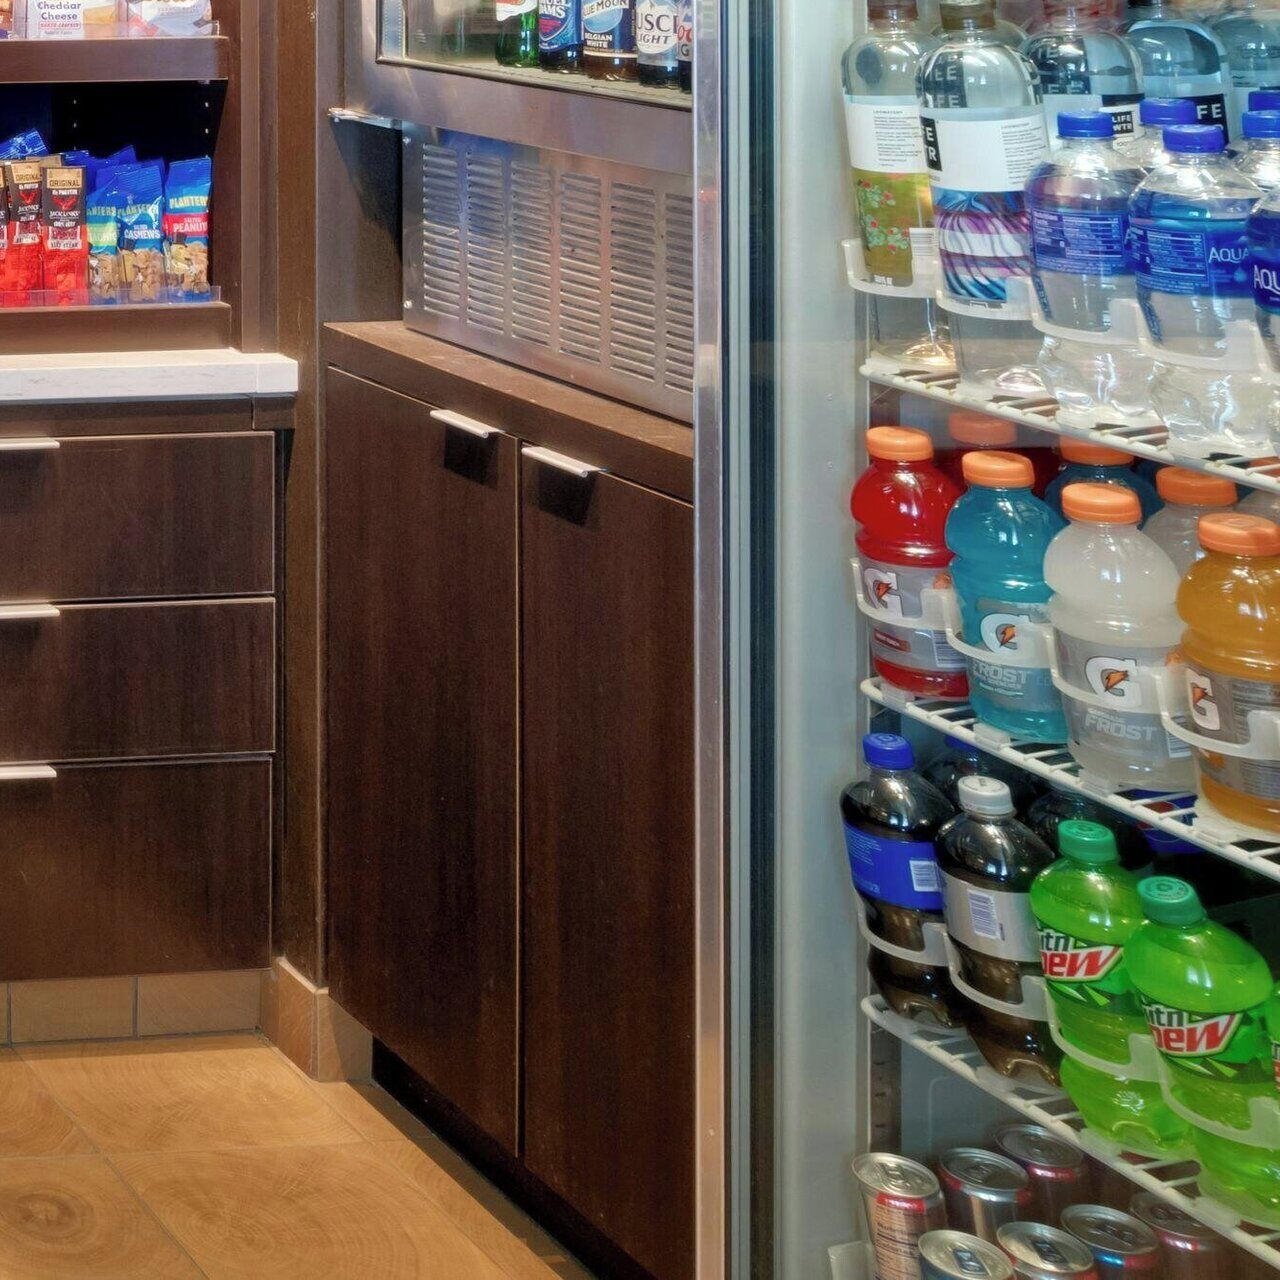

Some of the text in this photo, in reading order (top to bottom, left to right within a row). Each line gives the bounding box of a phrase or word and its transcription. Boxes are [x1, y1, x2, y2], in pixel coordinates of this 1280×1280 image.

[37, 1, 82, 10] Cheddar
[41, 12, 78, 21] Cheese
[585, 32, 613, 42] BELGIAN
[586, 40, 608, 49] WHITE
[49, 179, 80, 187] ORIGINAL
[124, 229, 161, 240] CASHEWS
[973, 662, 1028, 686] FROST
[1084, 718, 1158, 742] FROST
